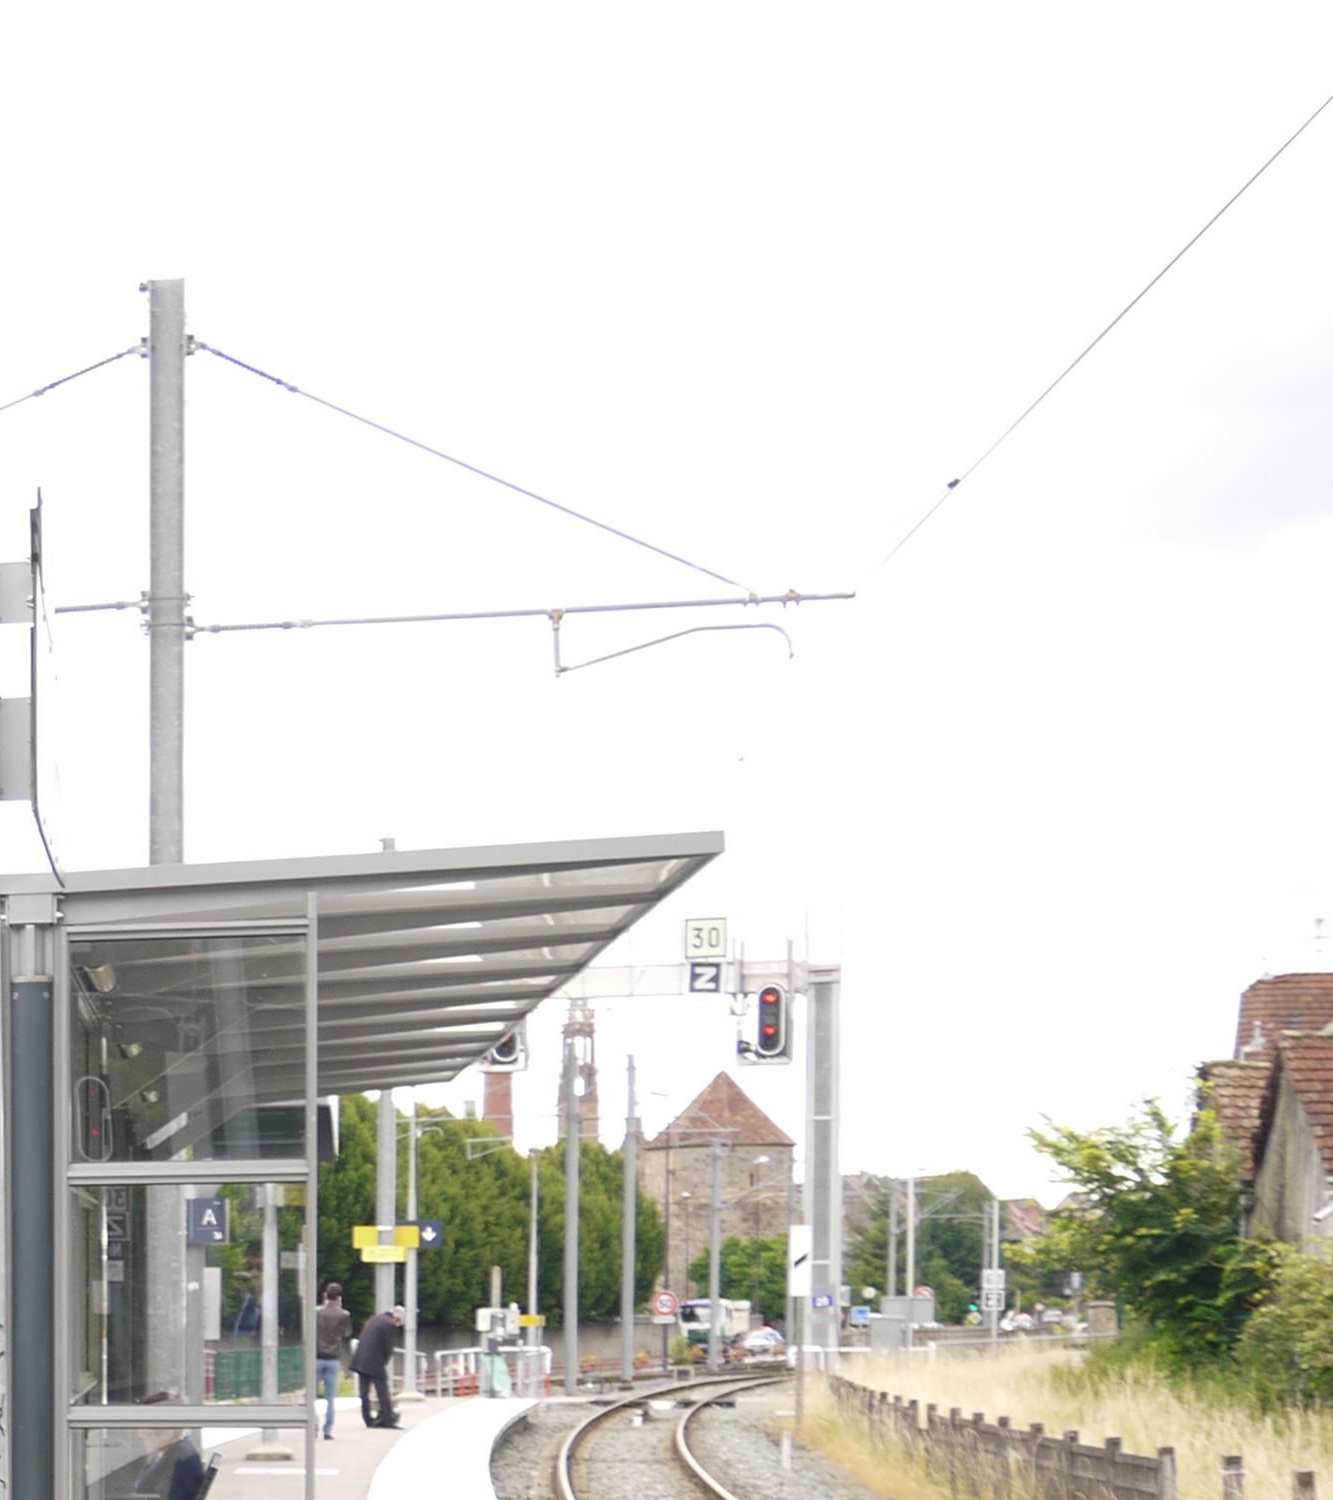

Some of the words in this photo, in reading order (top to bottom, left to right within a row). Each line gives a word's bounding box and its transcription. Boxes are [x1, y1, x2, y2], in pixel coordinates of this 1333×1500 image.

[690, 926, 721, 949] 30
[692, 966, 718, 991] Z
[201, 1208, 218, 1226] A
